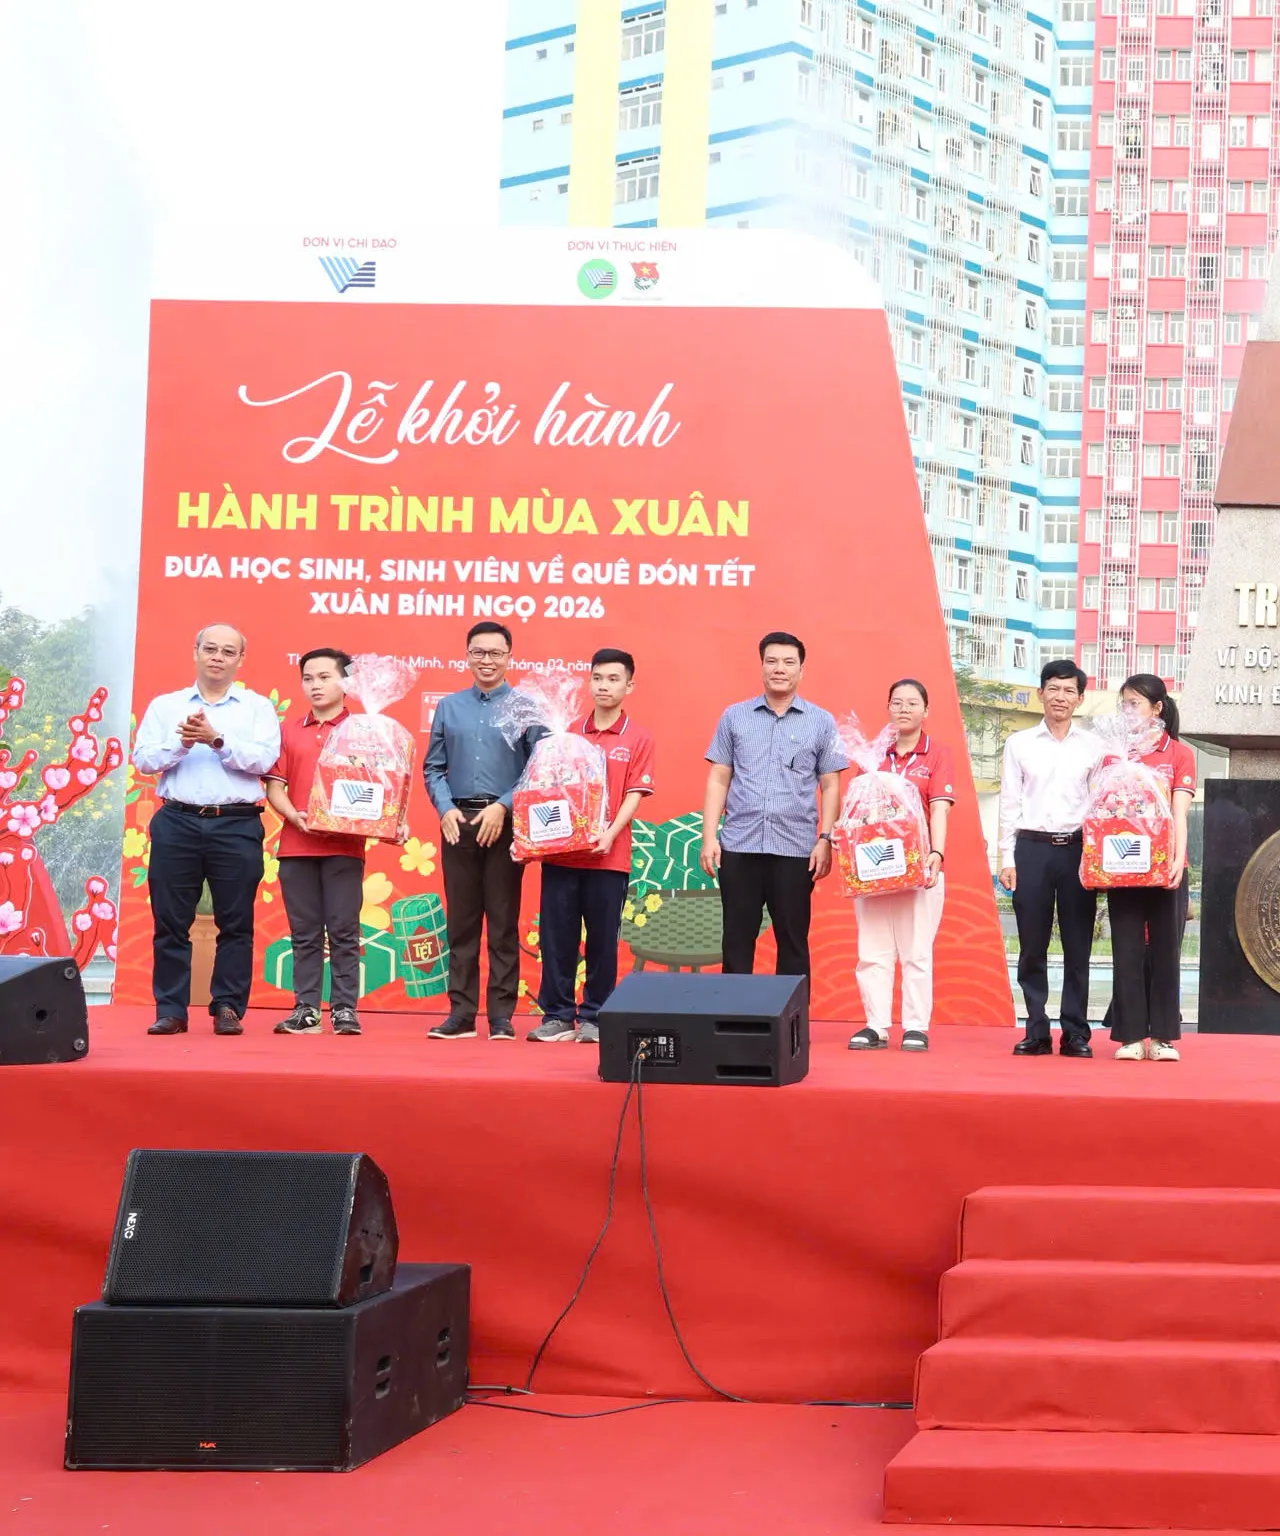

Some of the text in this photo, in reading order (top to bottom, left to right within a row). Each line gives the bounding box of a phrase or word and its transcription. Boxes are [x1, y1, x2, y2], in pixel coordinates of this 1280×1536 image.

[239, 370, 681, 464] Lễ khởi hành
[177, 483, 749, 537] HÀNH TRÌNH MÙA XUÂN
[165, 554, 756, 587] ĐƯA HỌC SINH, SINH VIÊN VỀ QUÊ ĐÓN TẾT
[309, 589, 605, 623] XUÂN BÍNH NGỌ 2026
[409, 656, 445, 670] Minh,
[1217, 645, 1238, 668] VĨ
[1243, 645, 1279, 672] ĐỘ:
[1214, 684, 1263, 705] KINH
[412, 939, 433, 960] TẾT
[124, 1212, 138, 1239] NEXO
